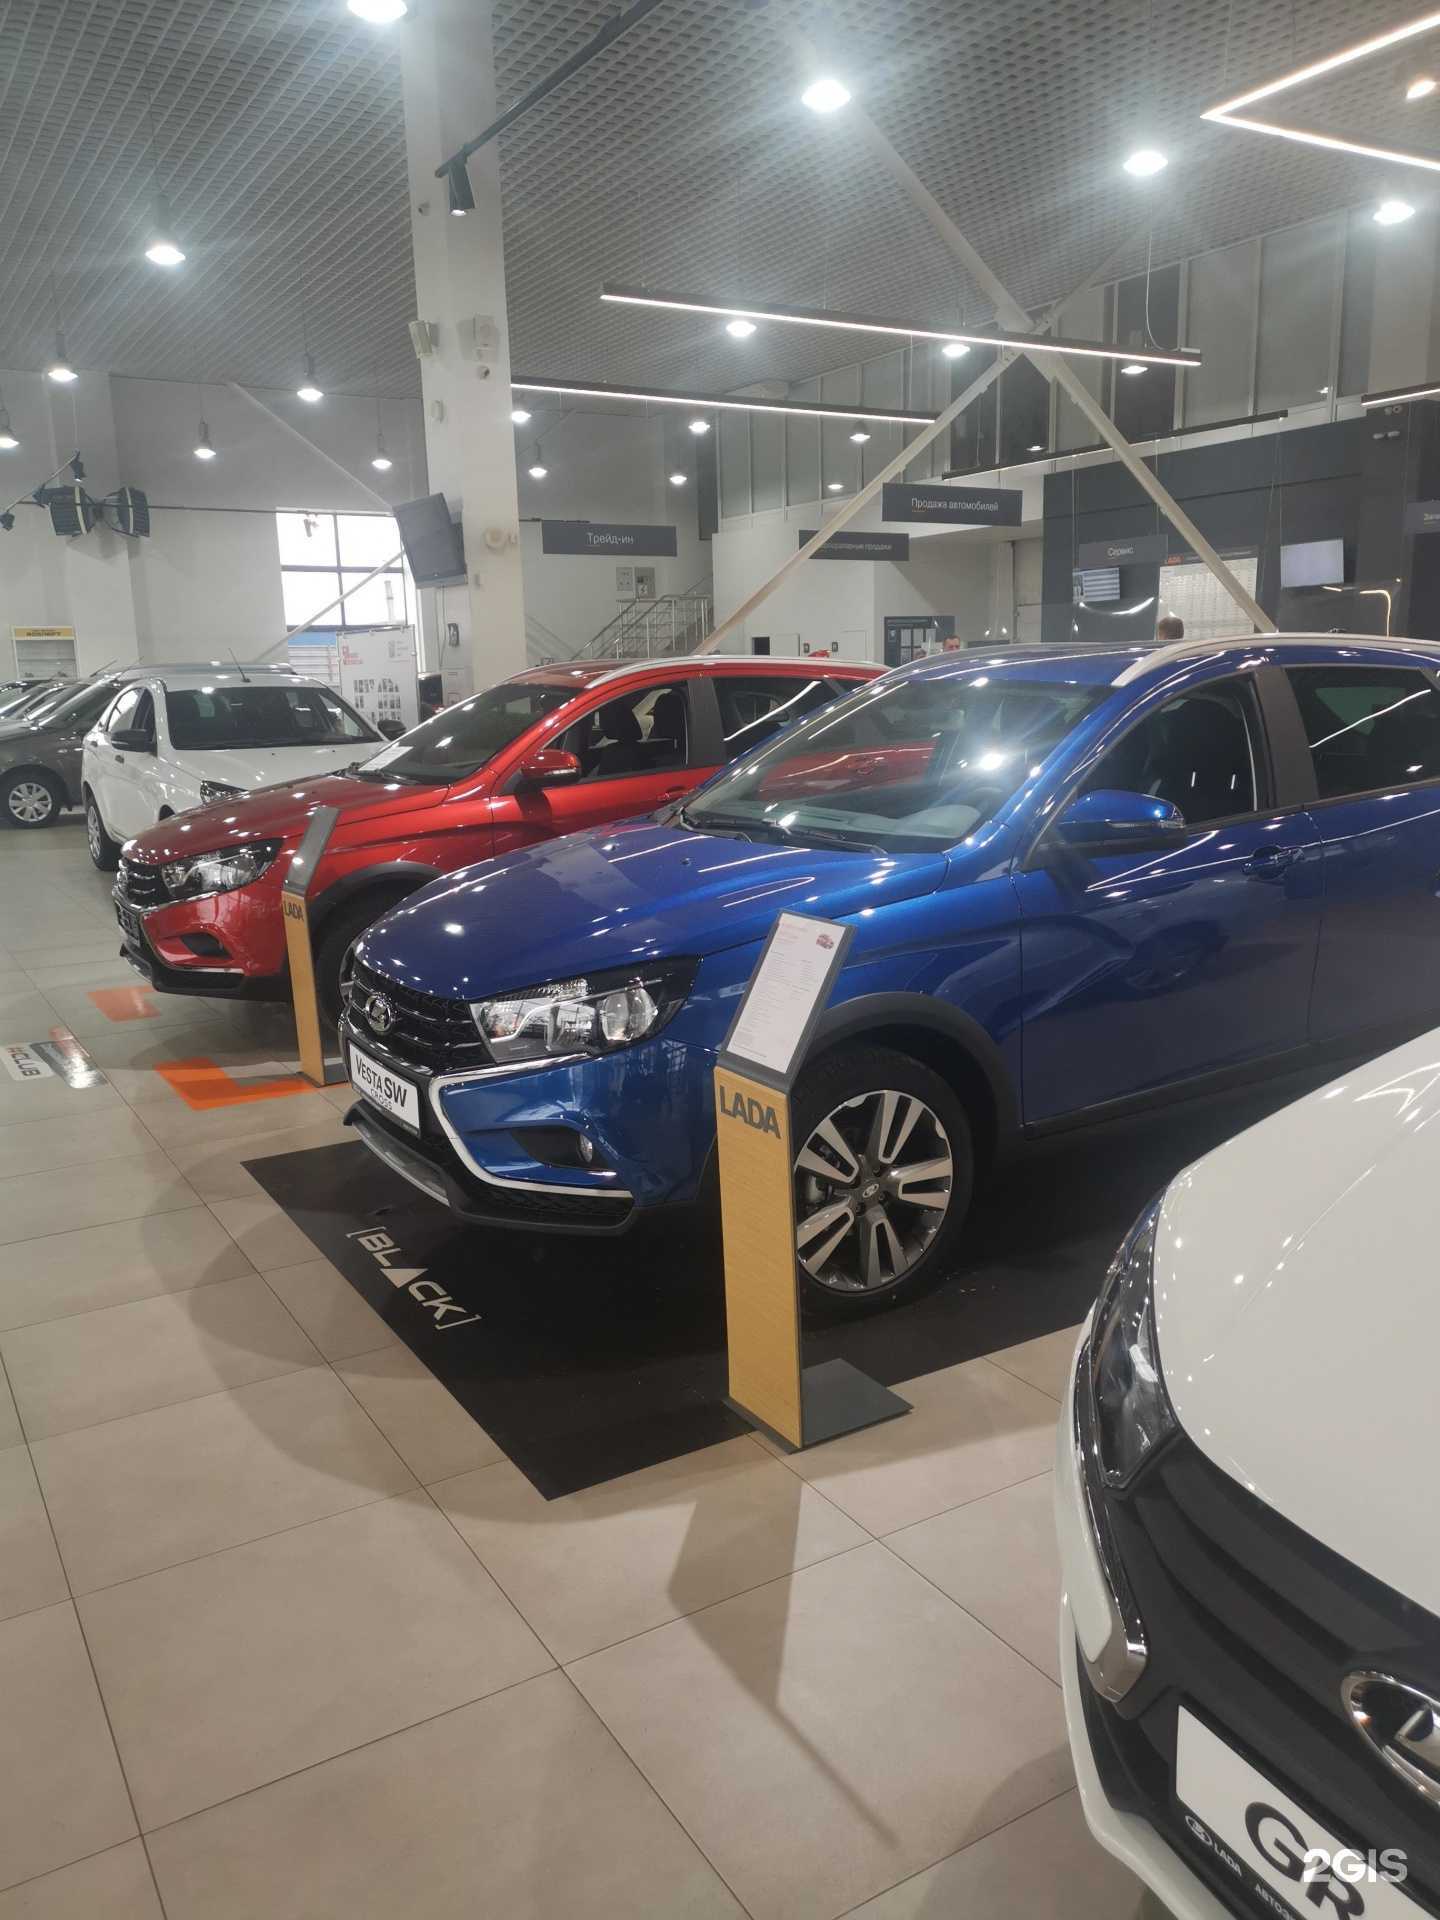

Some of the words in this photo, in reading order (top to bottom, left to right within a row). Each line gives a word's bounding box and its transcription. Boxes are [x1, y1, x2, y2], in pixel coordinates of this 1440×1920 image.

[911, 497, 947, 509] Продажа
[948, 500, 999, 512] автомобилей
[587, 532, 634, 545] Трейд-ин
[284, 900, 305, 922] LADA
[355, 1054, 383, 1094] VESTA
[384, 1077, 408, 1108] SW
[370, 1088, 393, 1111] CROSS
[719, 1084, 782, 1140] LADA
[1213, 1842, 1243, 1877] LADA
